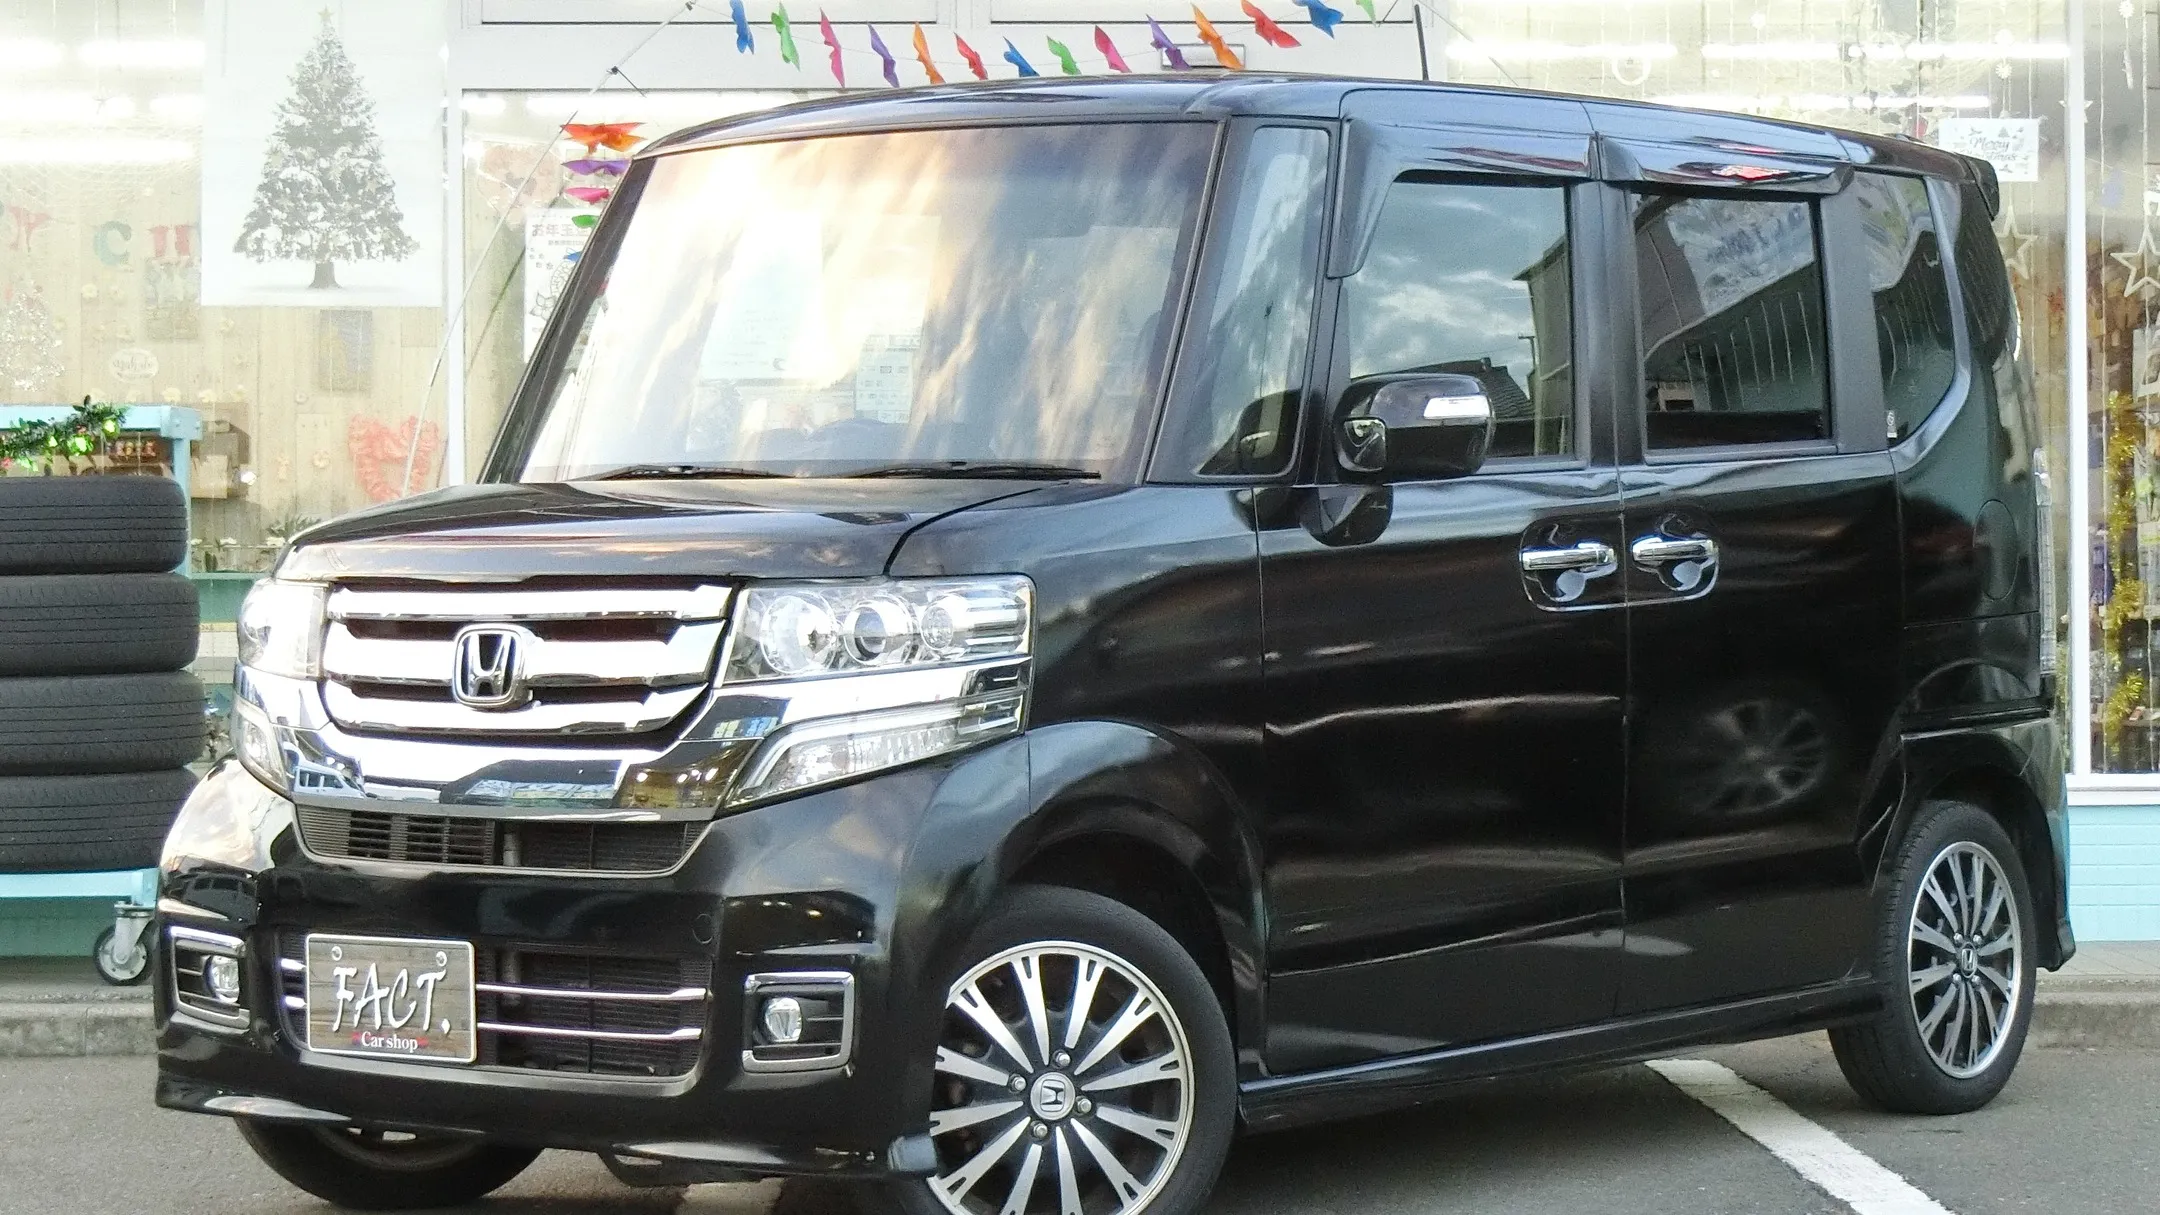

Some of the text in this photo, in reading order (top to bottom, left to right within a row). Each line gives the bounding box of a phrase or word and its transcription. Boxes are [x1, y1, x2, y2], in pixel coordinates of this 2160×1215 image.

[332, 962, 451, 1035] FACT.
[361, 1031, 419, 1053] Car shop
